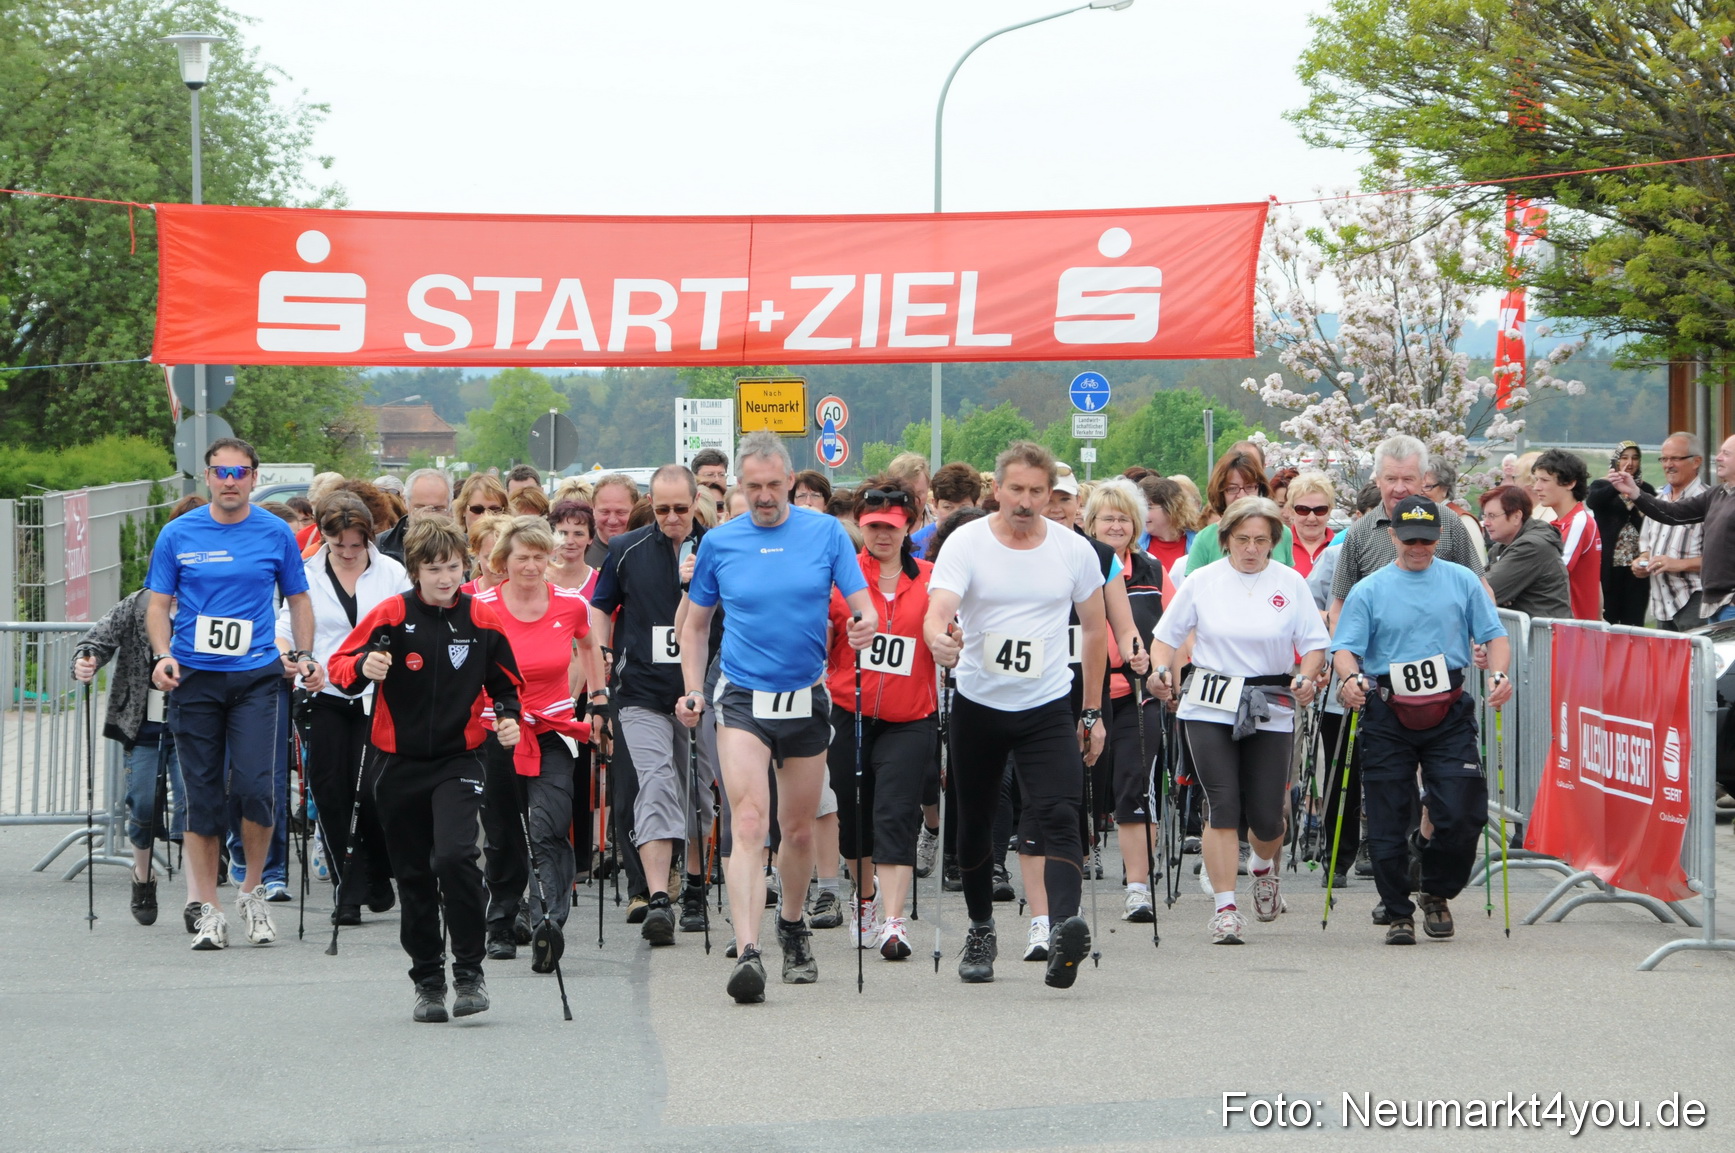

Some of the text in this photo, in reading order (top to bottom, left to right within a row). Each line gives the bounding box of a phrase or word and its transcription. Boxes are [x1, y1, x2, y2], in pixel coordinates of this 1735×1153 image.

[745, 400, 800, 413] Neumarkt
[824, 406, 841, 421] 60
[208, 620, 241, 650] 50
[870, 635, 905, 667] 90
[996, 639, 1031, 672] 45
[1200, 673, 1231, 704] 117
[1402, 660, 1437, 692] 89
[1615, 732, 1629, 783] BEI
[1630, 734, 1651, 788] SEAT
[1663, 787, 1682, 802] SEAT
